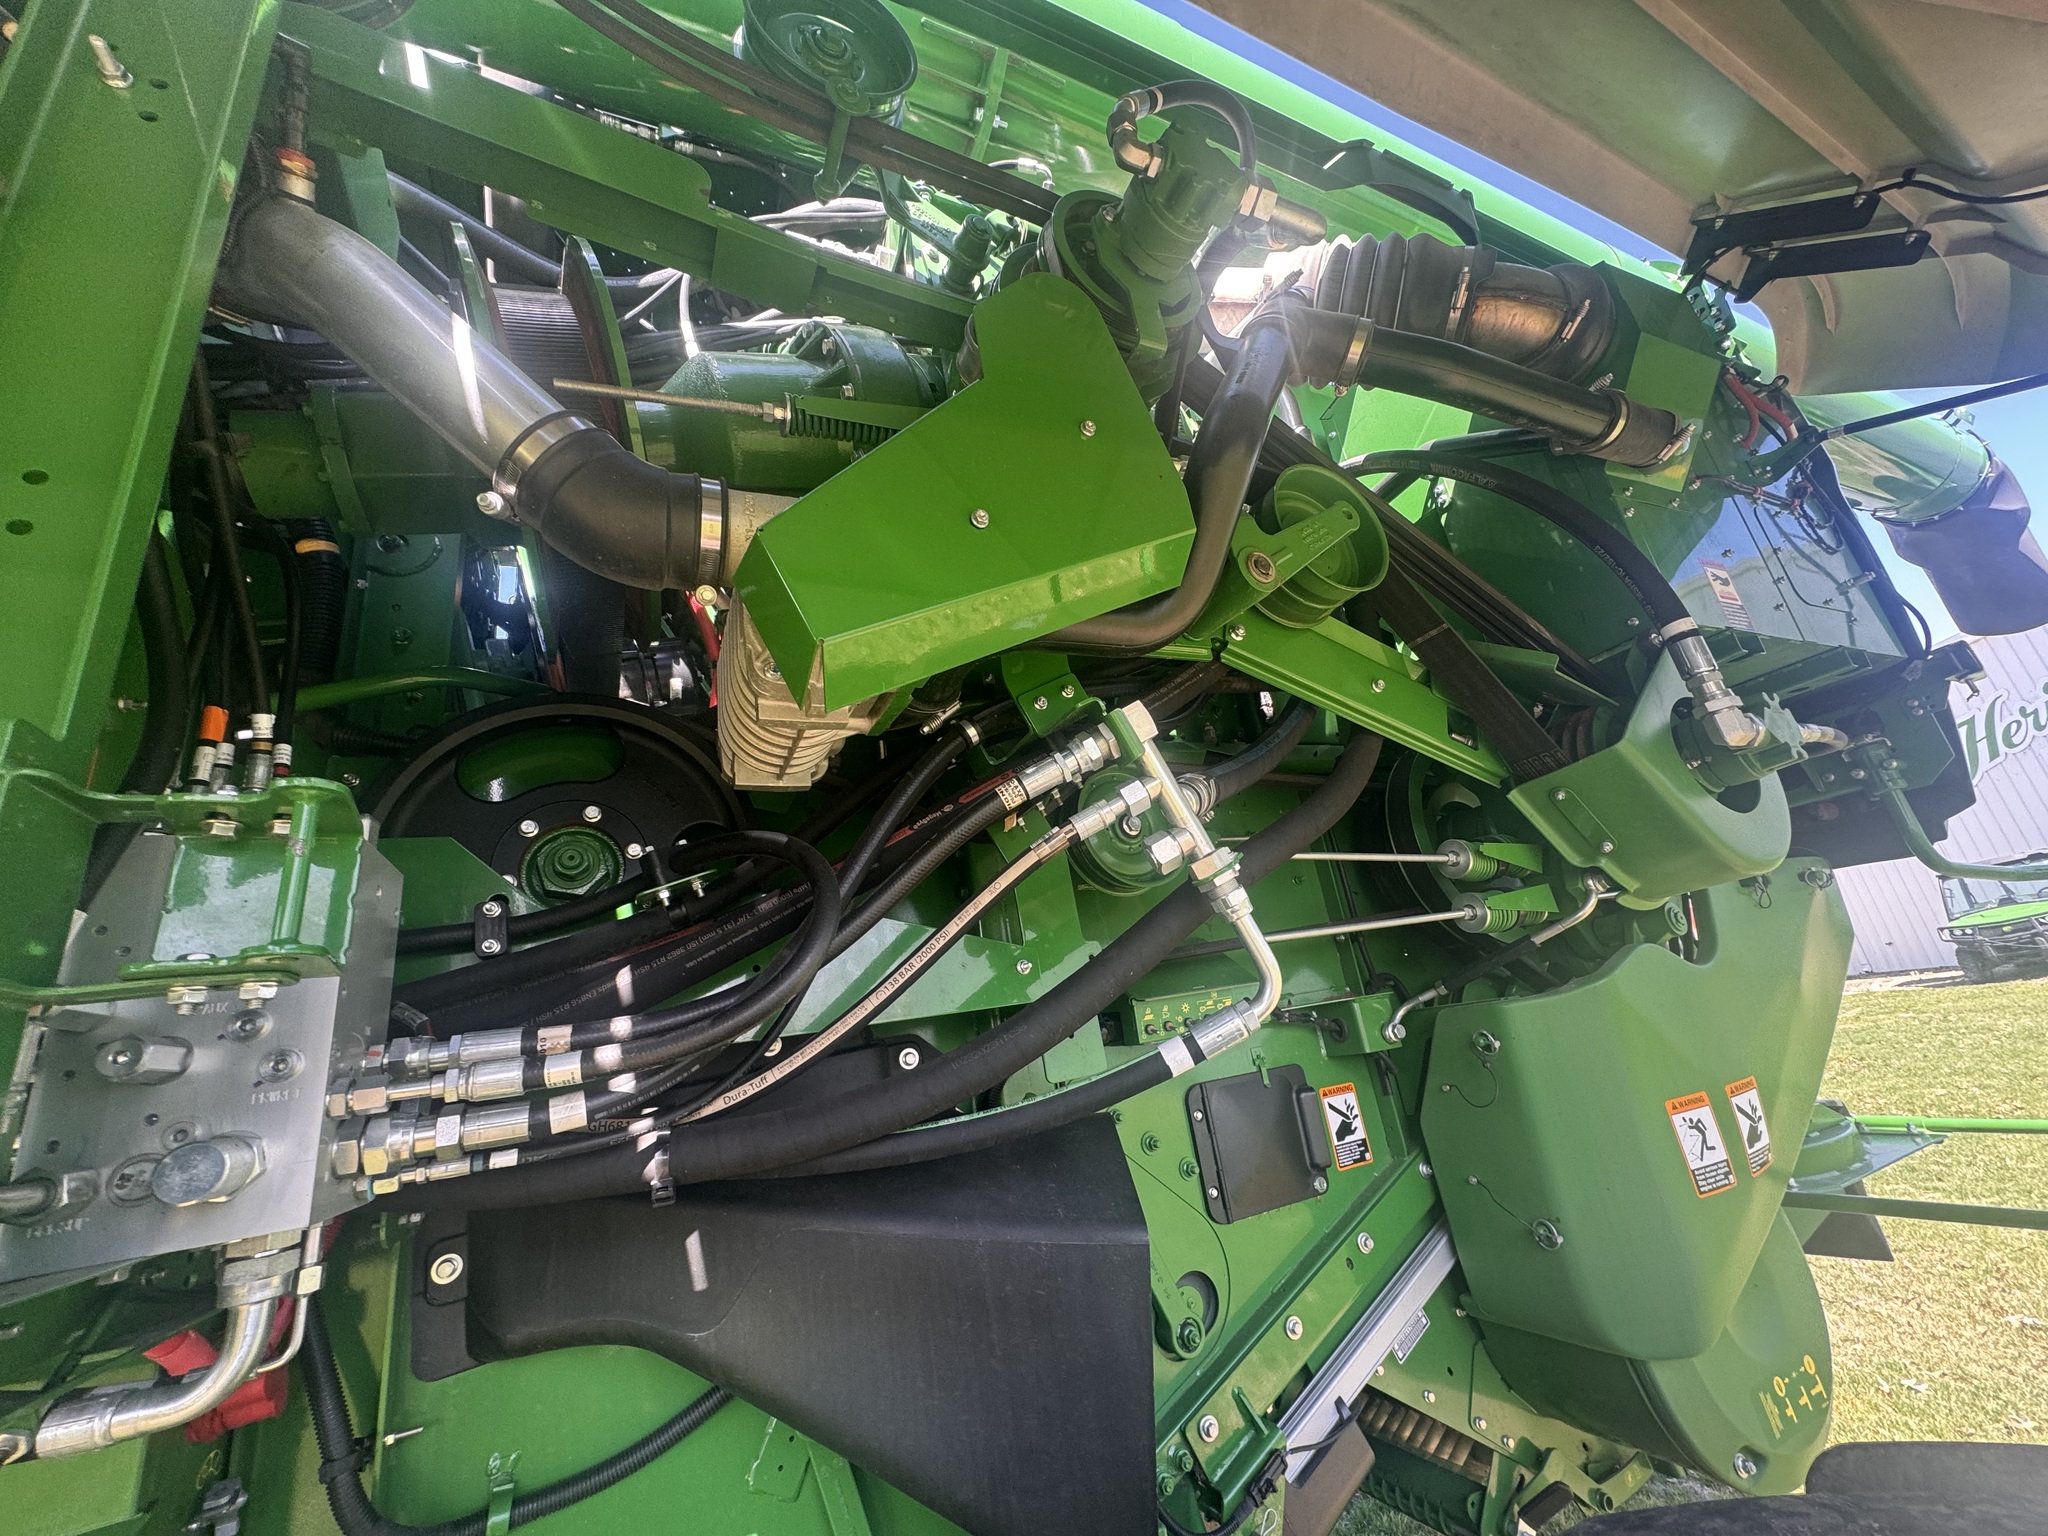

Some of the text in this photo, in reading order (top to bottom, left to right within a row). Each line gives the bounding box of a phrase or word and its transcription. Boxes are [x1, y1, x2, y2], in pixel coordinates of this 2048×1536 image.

[1428, 461, 1489, 486] ALFAGOMMA
[1622, 575, 1644, 600] MSHA
[882, 928, 951, 993] 138 BAR (2000 PSI)
[722, 1076, 769, 1105] Dura-Tuff
[1327, 1084, 1353, 1096] WARNING
[1734, 1079, 1754, 1092] WARNING
[1677, 1095, 1705, 1108] WARNING
